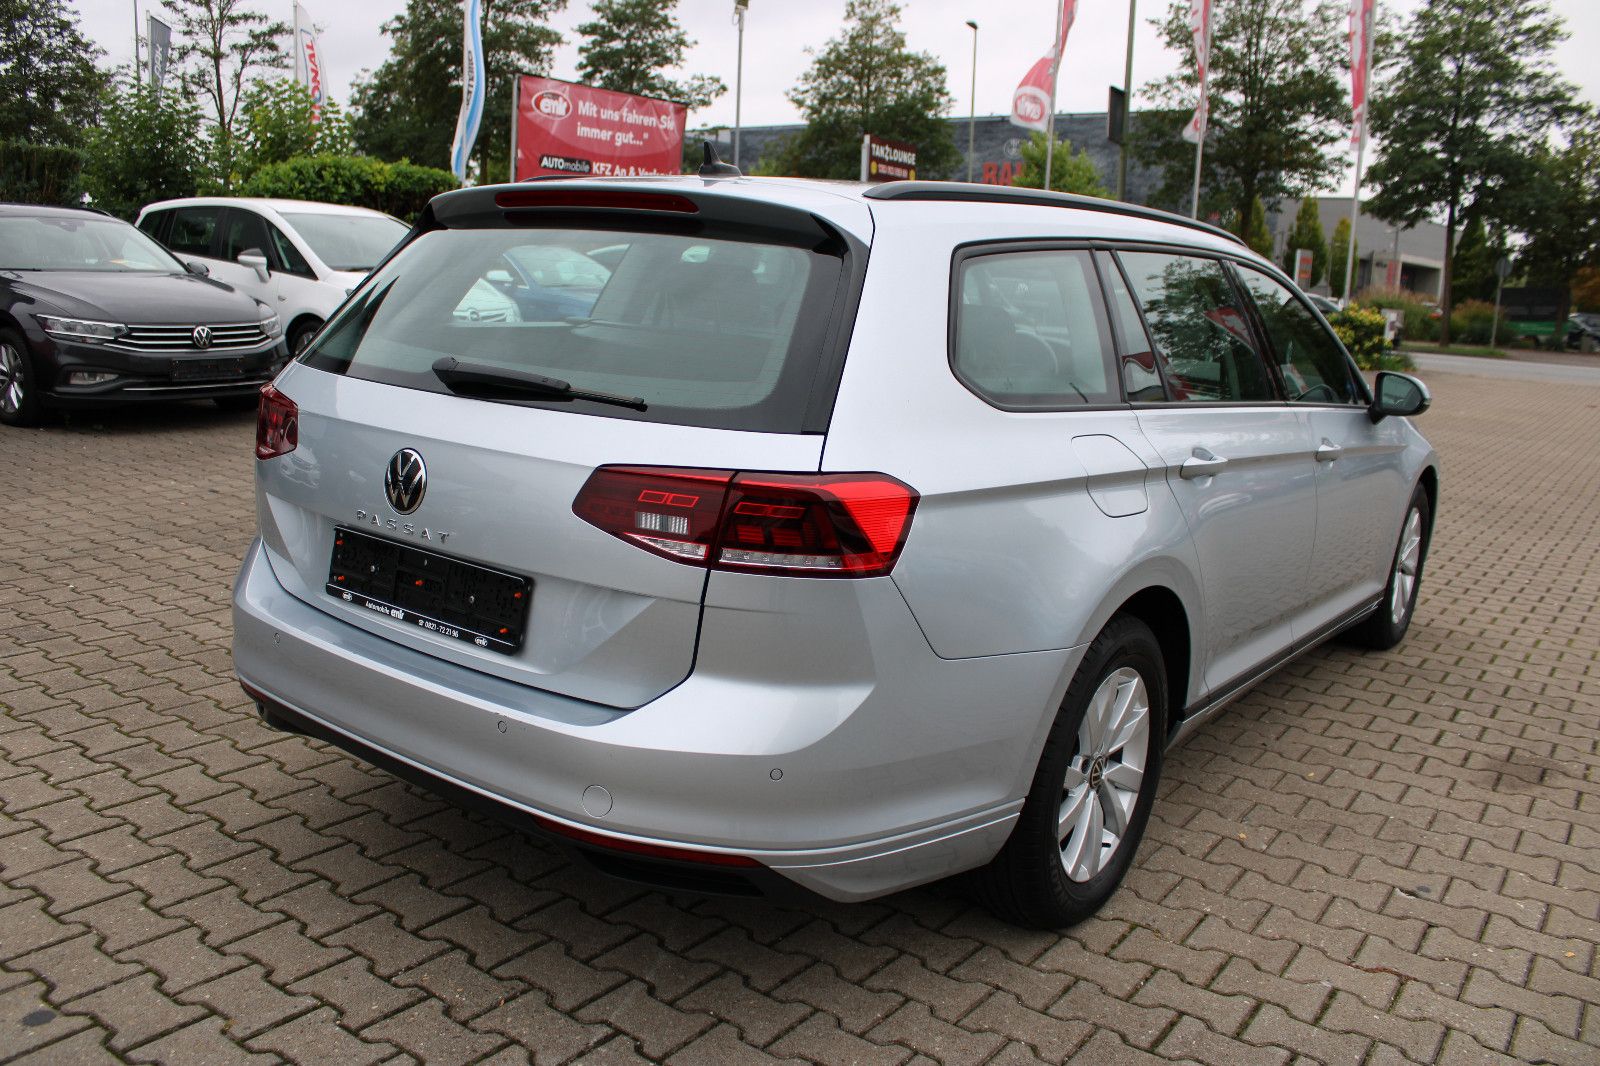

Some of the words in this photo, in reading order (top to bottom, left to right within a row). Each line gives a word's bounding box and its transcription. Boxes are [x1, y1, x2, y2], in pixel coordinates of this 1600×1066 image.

[578, 100, 597, 118] Mit
[600, 107, 620, 121] uns
[622, 107, 656, 127] fahren
[577, 121, 612, 141] immer
[541, 156, 591, 172] AUTOmobile
[592, 161, 612, 175] KFZ
[356, 509, 450, 544] PASSAT
[365, 600, 390, 615] Automobile
